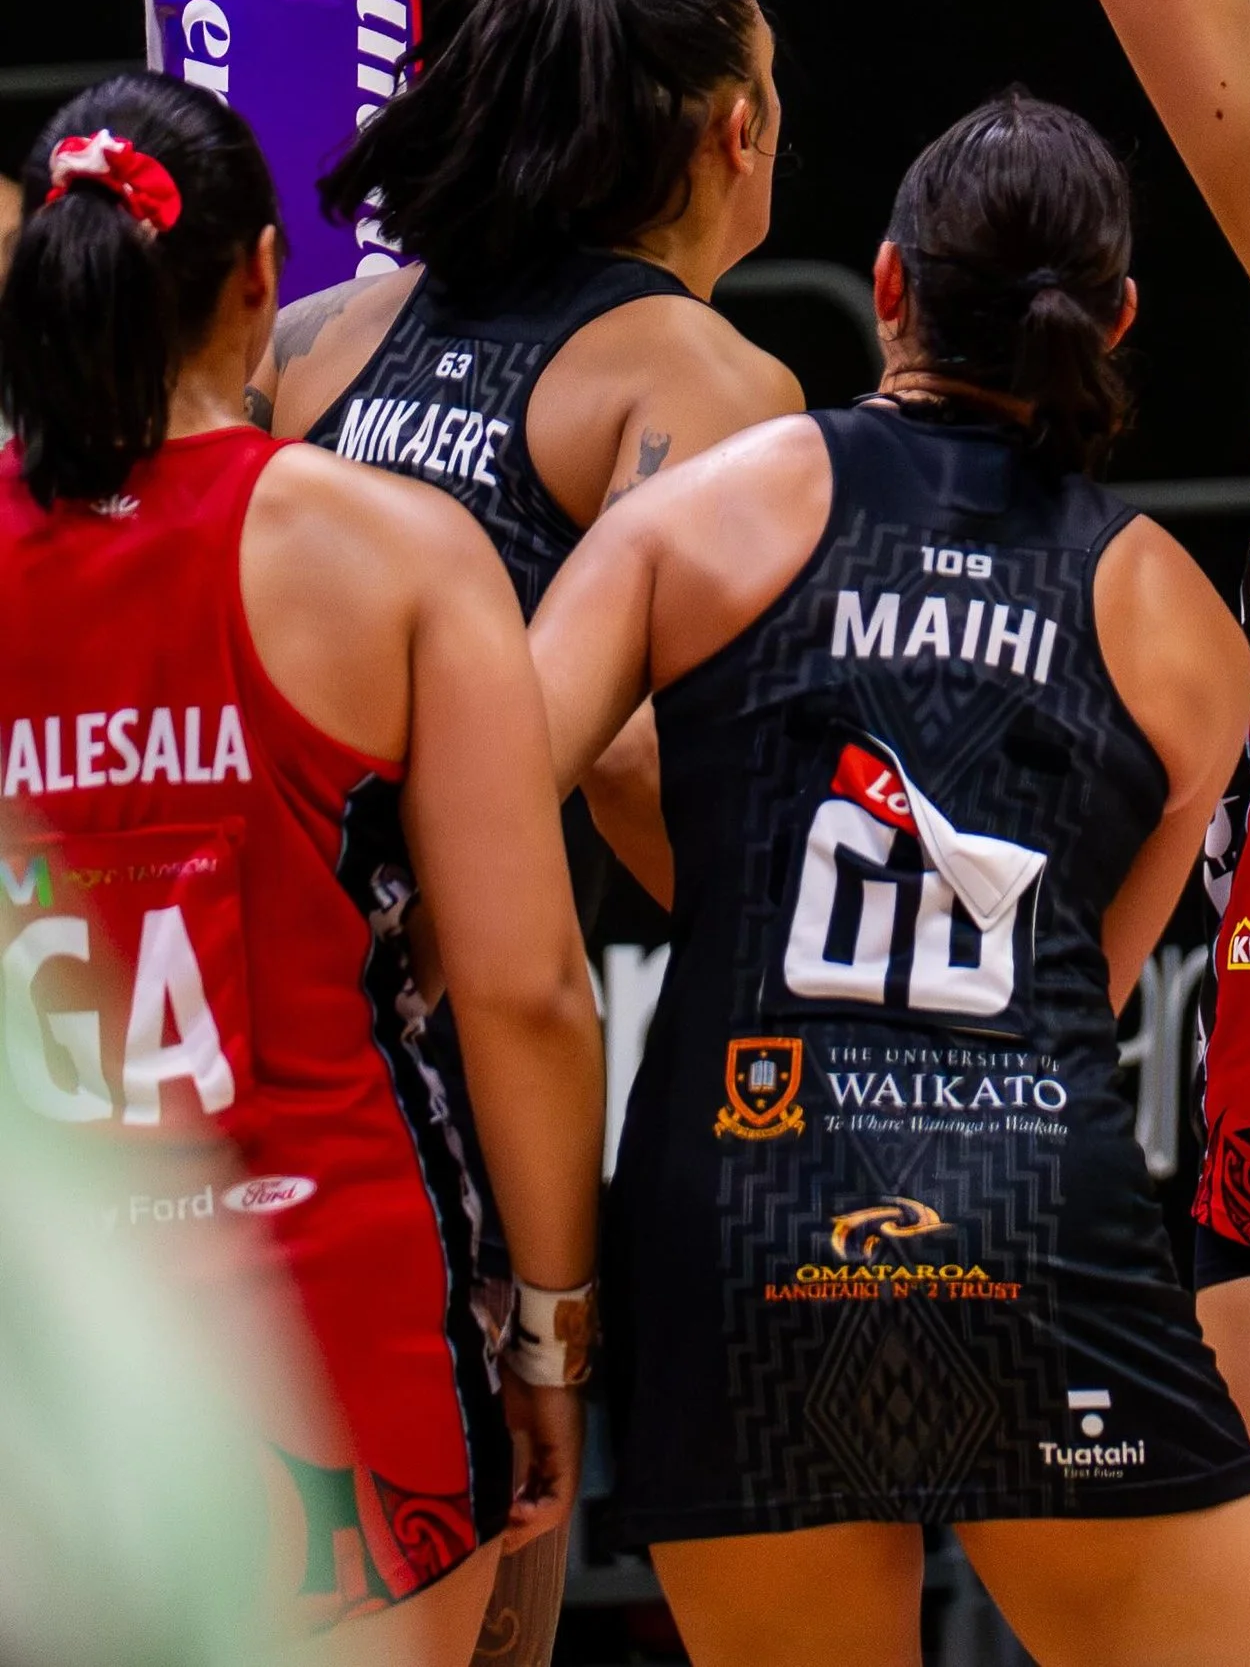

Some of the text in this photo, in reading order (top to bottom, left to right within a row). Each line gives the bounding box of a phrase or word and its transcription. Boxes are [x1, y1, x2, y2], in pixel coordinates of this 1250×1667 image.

[435, 352, 473, 379] 63
[336, 398, 510, 486] MIKAERE
[920, 545, 993, 580] 109
[830, 589, 1058, 685] MAIHI
[3, 704, 252, 797] ALESALA
[0, 905, 236, 1126] GA
[828, 1046, 872, 1063] THE
[885, 1047, 1029, 1068] UNIVERSITY
[826, 1071, 1068, 1112] WAIKATO
[129, 1184, 215, 1225] Ford
[946, 1282, 1022, 1301] TRUST
[1038, 1439, 1145, 1466] Tuatahi
